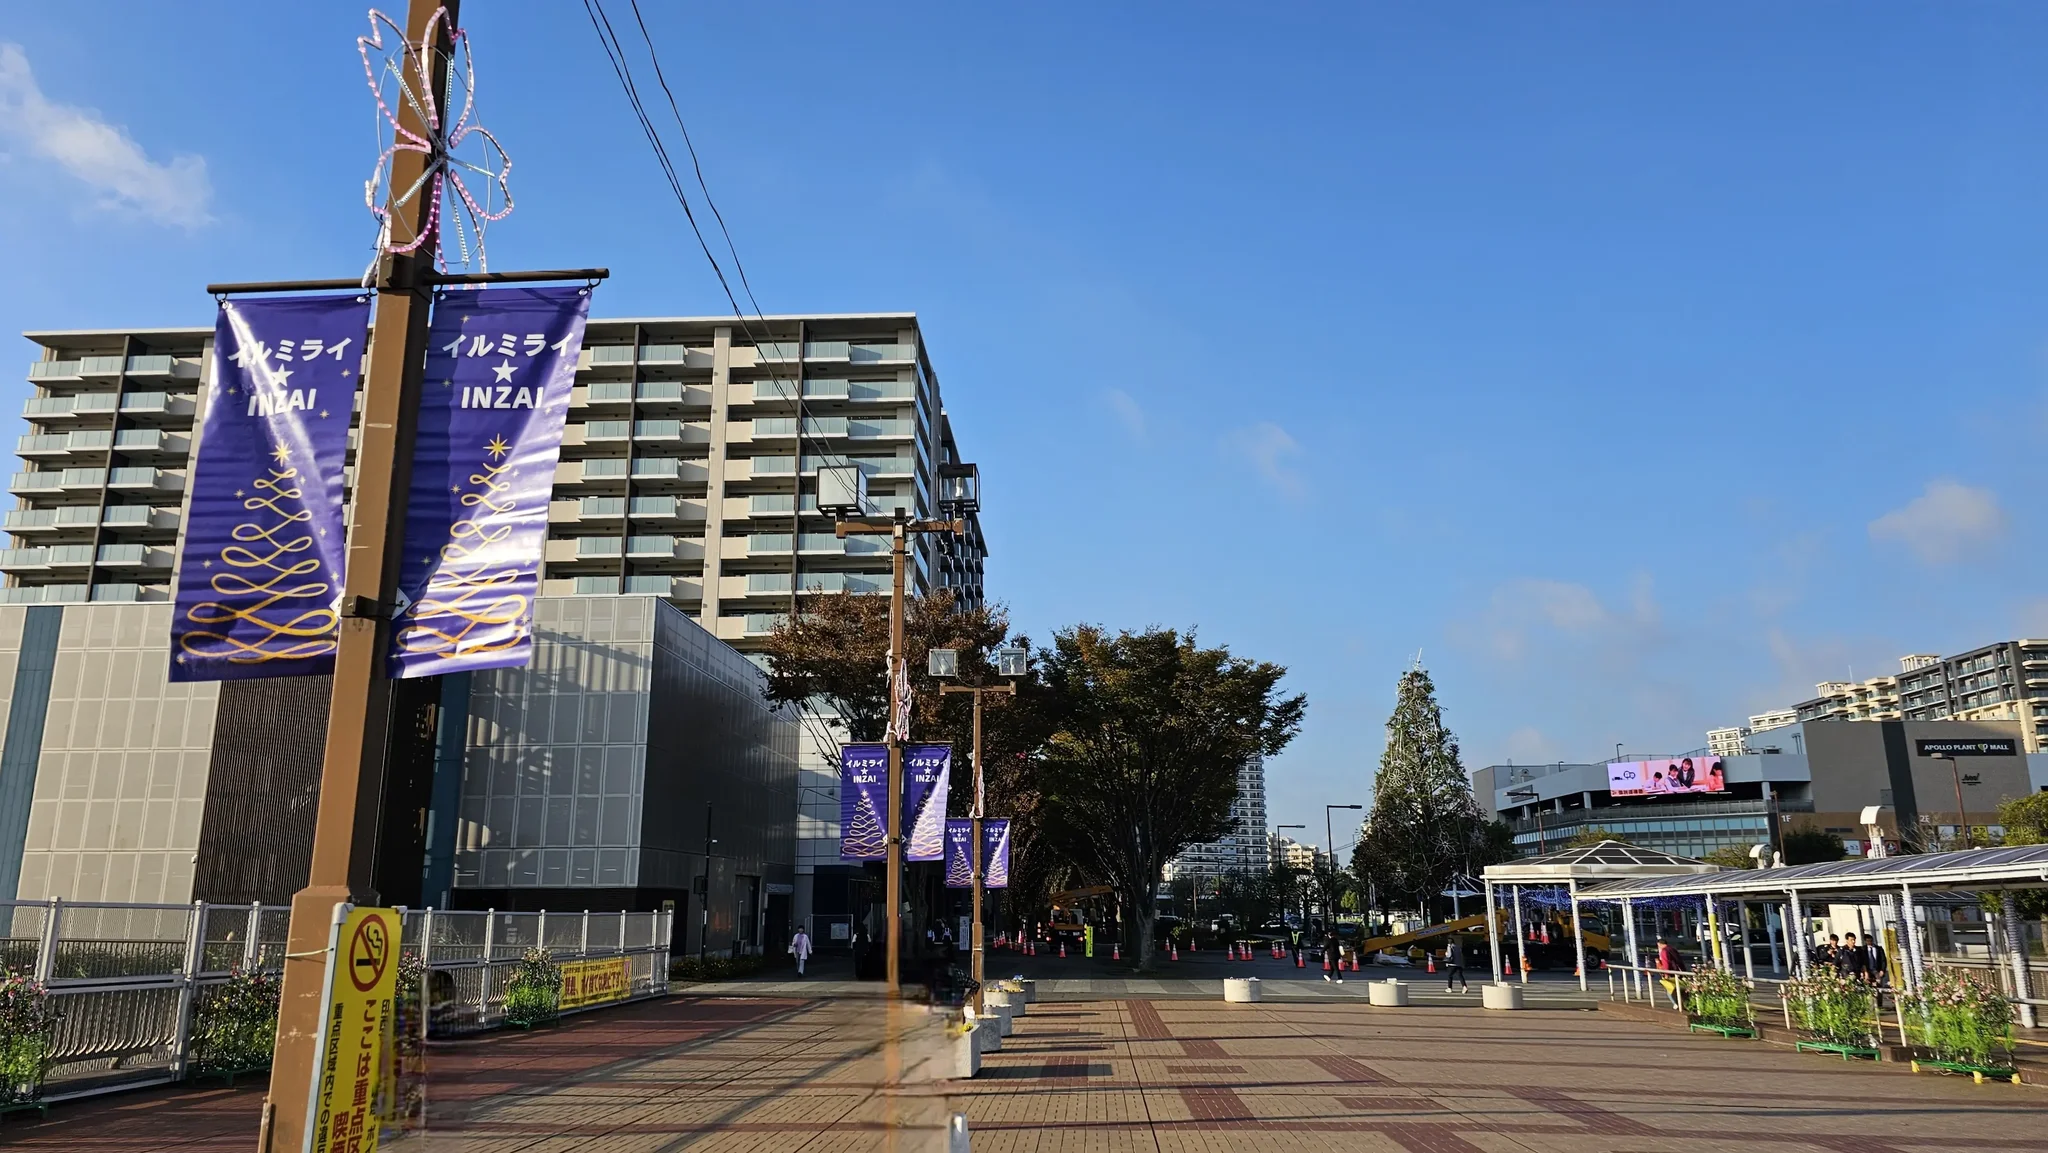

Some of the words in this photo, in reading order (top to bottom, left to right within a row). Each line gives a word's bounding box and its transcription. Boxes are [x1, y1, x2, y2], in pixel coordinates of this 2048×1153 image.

[227, 337, 352, 367] イルミライ
[442, 332, 574, 359] イルミライ
[247, 388, 317, 416] INZAI
[461, 386, 543, 409] INZAI
[846, 759, 884, 767] イルミライ
[908, 758, 947, 767] イルミライ
[853, 775, 876, 783] INZAI
[915, 774, 940, 783] INZAI
